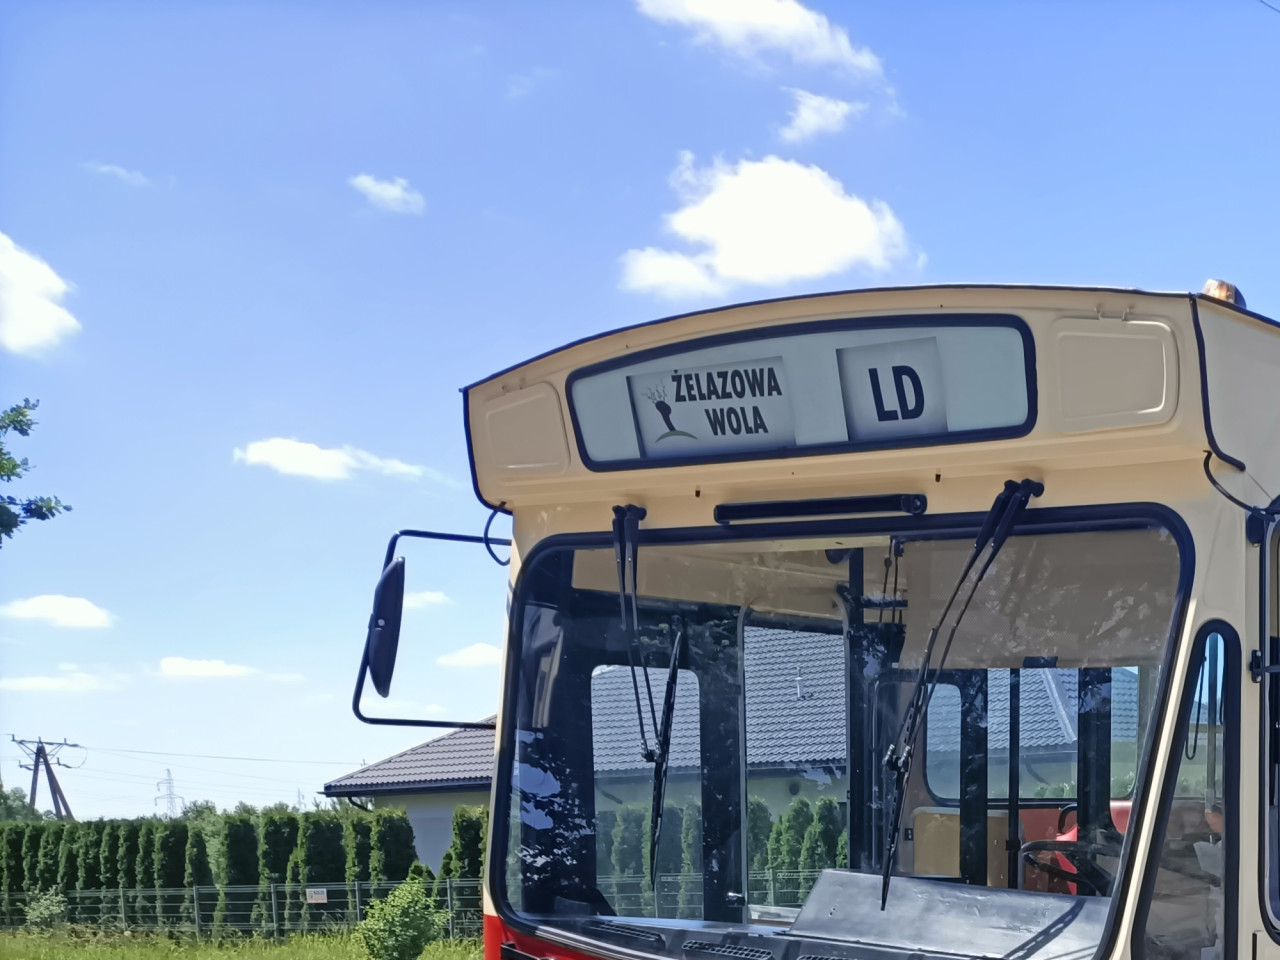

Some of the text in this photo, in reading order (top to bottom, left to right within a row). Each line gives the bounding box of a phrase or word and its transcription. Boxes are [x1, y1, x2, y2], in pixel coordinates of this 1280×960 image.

[671, 367, 782, 402] ŻELAZOWA
[868, 365, 925, 422] LD
[704, 406, 769, 436] WOLA
